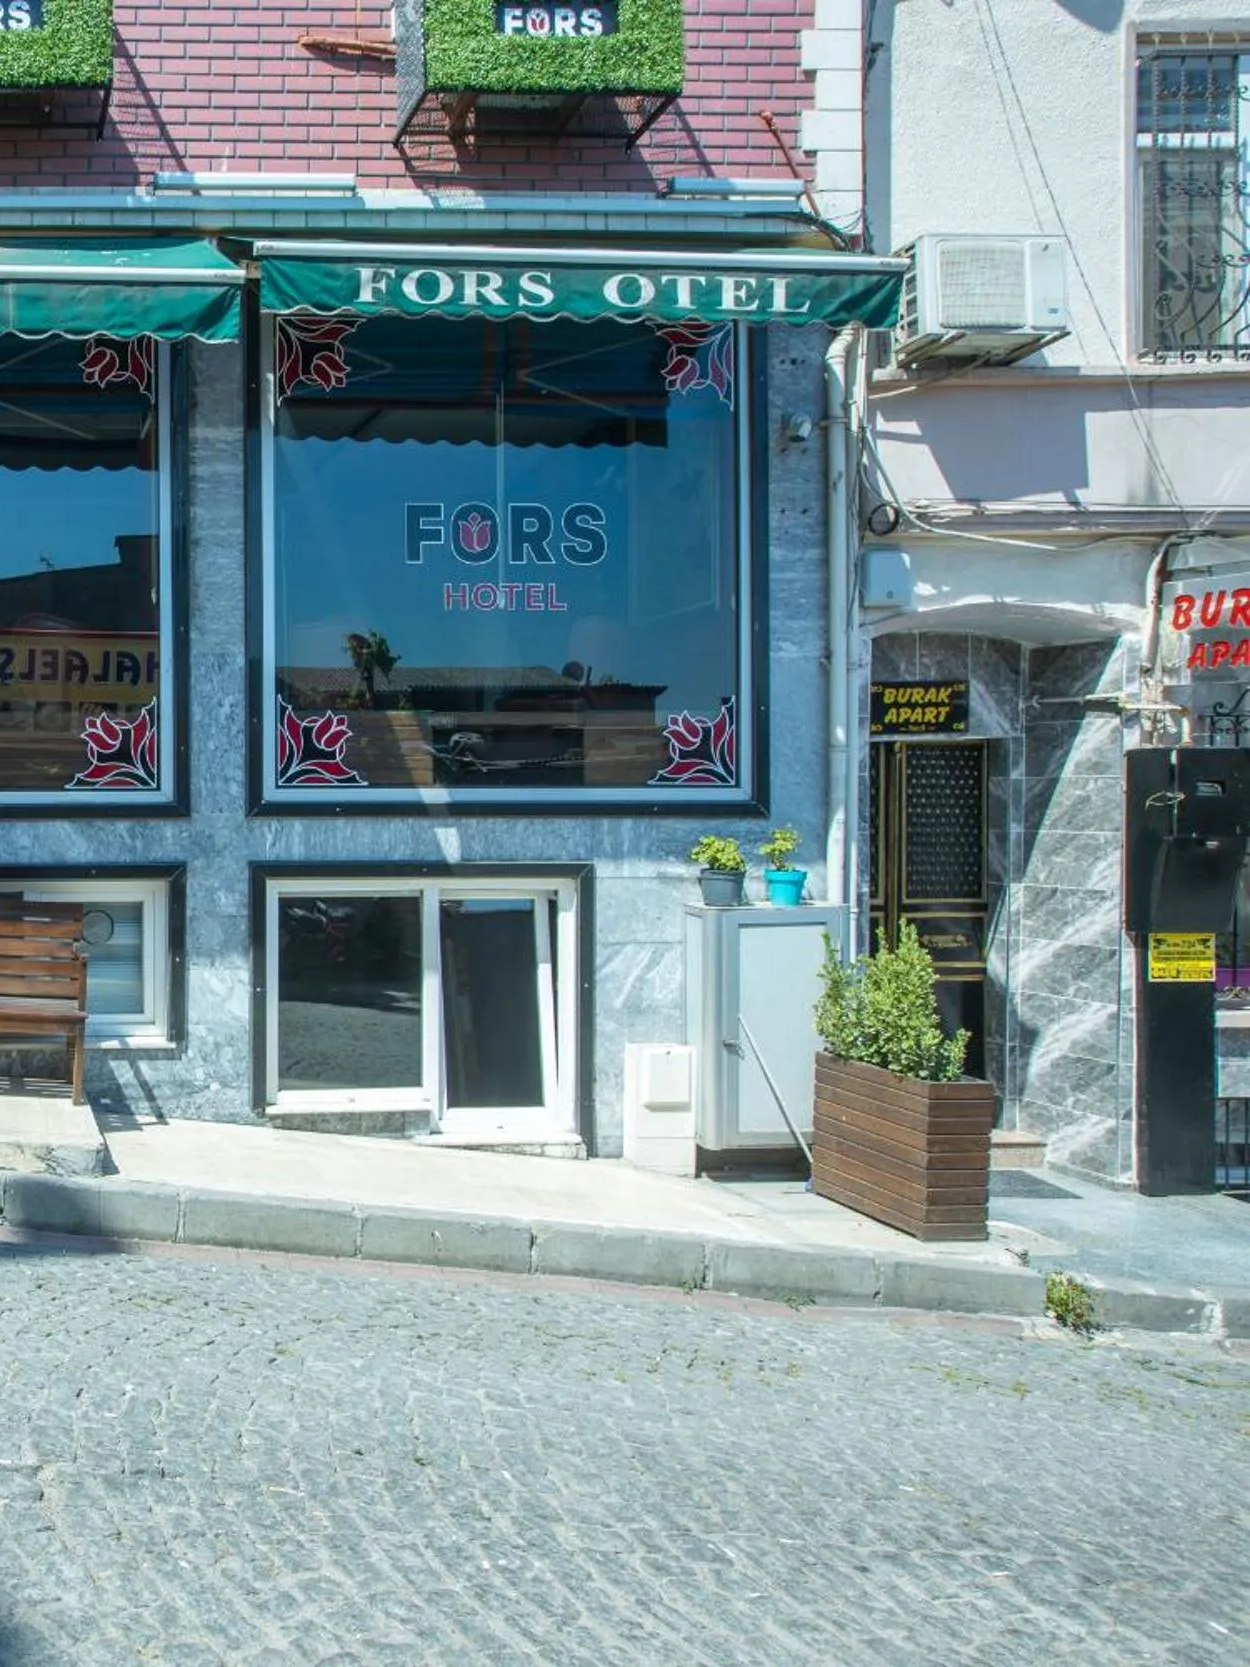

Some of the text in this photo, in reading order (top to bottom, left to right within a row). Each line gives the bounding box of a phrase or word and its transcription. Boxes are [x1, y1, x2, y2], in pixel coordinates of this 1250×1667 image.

[504, 7, 603, 37] FORS
[352, 266, 811, 314] FORS OTEL
[405, 501, 608, 566] FORS
[443, 582, 568, 612] HOTEL
[883, 687, 952, 704] BURAK
[884, 706, 950, 724] APART
